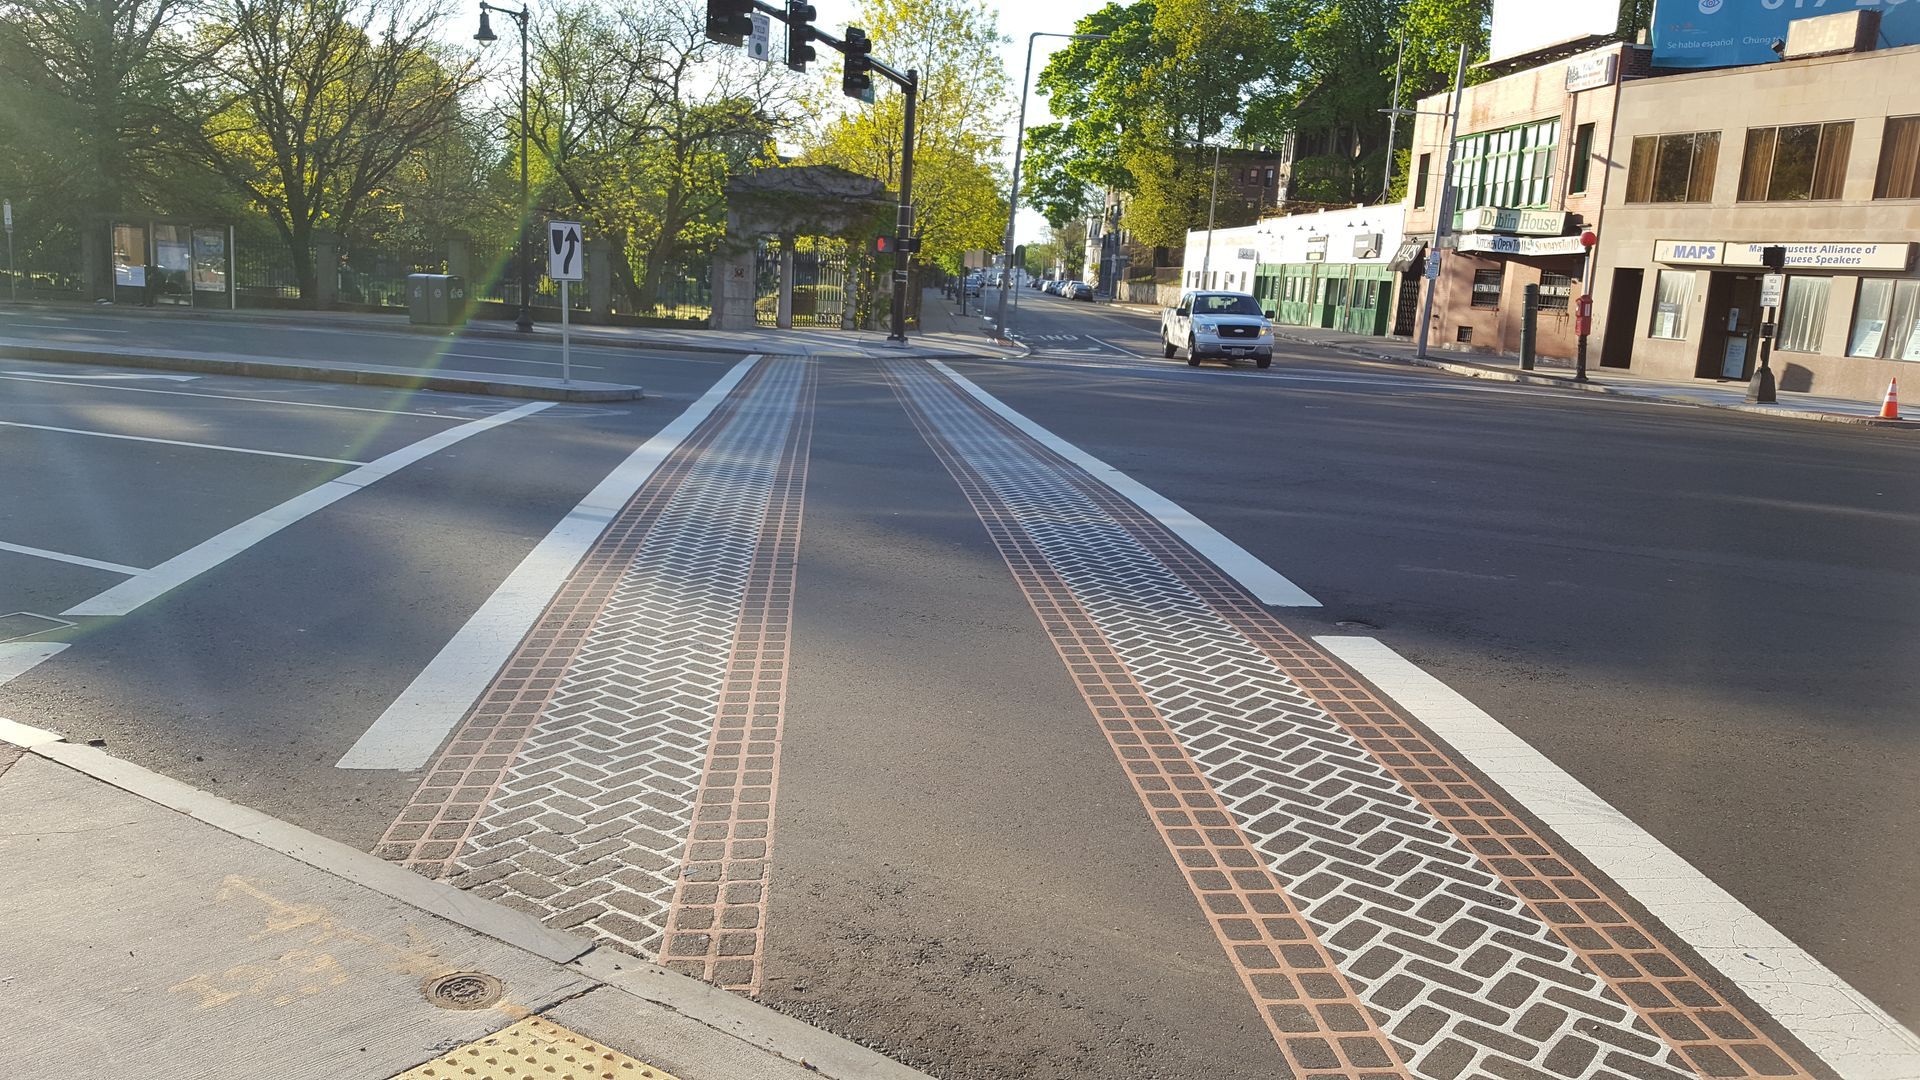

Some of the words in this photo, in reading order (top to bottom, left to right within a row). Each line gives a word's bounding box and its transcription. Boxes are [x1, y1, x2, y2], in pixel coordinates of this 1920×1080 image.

[1679, 40, 1700, 49] habla
[1482, 210, 1517, 229] Dublin
[1520, 212, 1557, 231] House
[1672, 245, 1716, 260] MAPS
[1819, 245, 1862, 254] Alliance
[1865, 245, 1878, 255] of
[1815, 255, 1862, 266] Speakers
